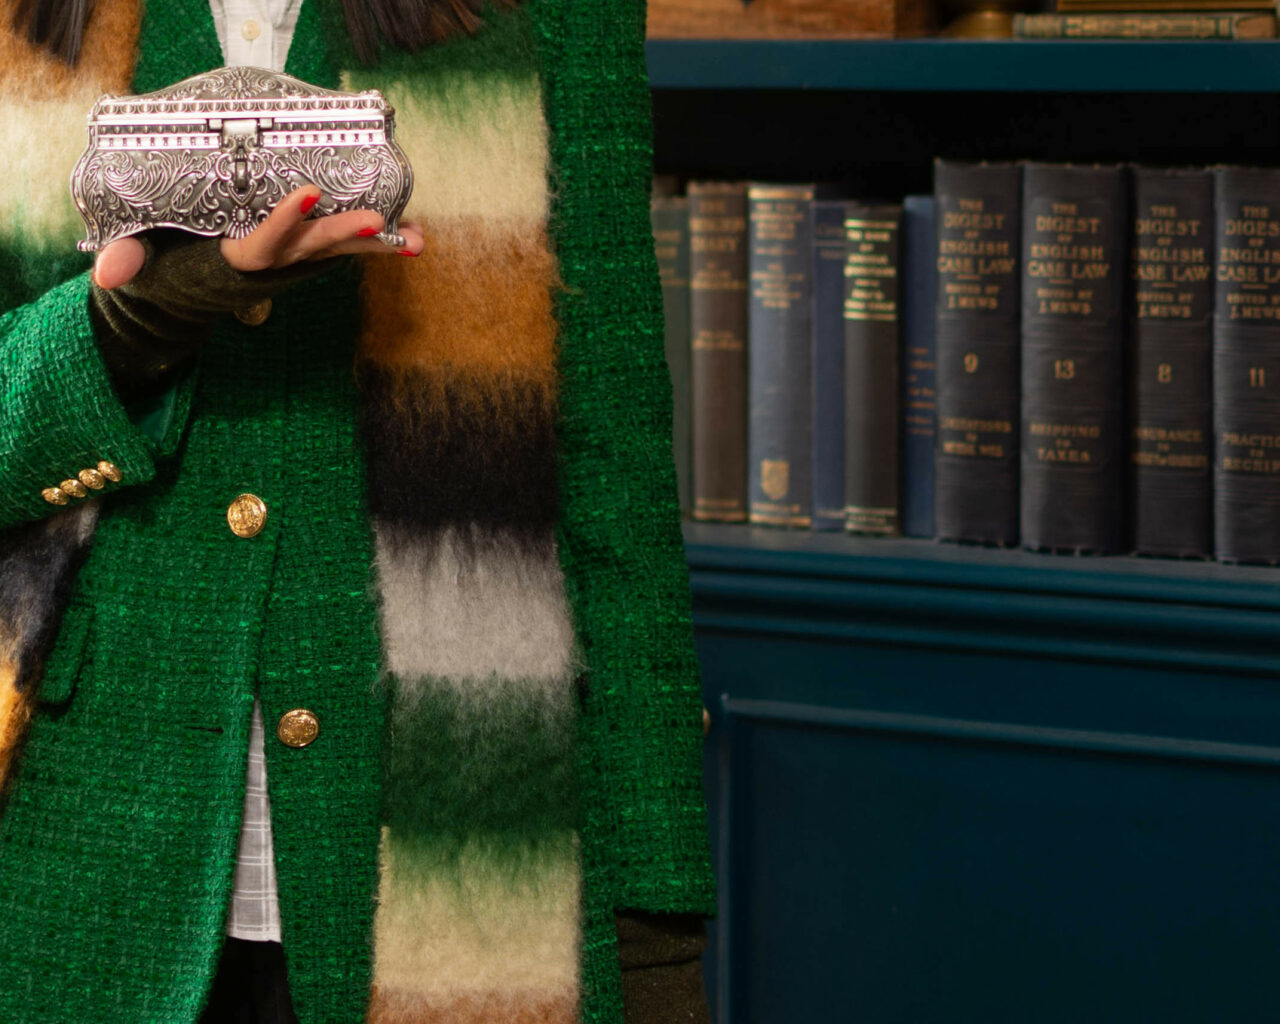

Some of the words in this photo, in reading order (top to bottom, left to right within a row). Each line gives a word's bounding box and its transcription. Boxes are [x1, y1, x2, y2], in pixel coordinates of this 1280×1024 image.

[959, 198, 983, 211] THE
[1051, 202, 1078, 215] THE
[1150, 205, 1176, 217] THE
[1241, 206, 1269, 218] THE
[944, 212, 1005, 229] DIGEST
[1035, 216, 1100, 233] DIGEST
[1225, 220, 1280, 236] DIGES
[939, 240, 1009, 255] ENGLISH
[1031, 244, 1103, 260] ENGLISH
[1132, 247, 1204, 262] NGLISH
[1220, 248, 1280, 263] ENGLIS
[937, 256, 973, 273] CASE
[978, 258, 1015, 274] LAW
[1028, 260, 1066, 277] CASE
[1072, 263, 1110, 279] LAW
[1132, 264, 1166, 280] ASE
[1172, 265, 1210, 281] LAW
[1217, 265, 1258, 282] CASE
[964, 353, 978, 373] 9
[1055, 359, 1075, 379] 13
[1158, 363, 1172, 383] 8
[1030, 423, 1101, 438] SHIPPING
[1037, 447, 1091, 462] TAXES
